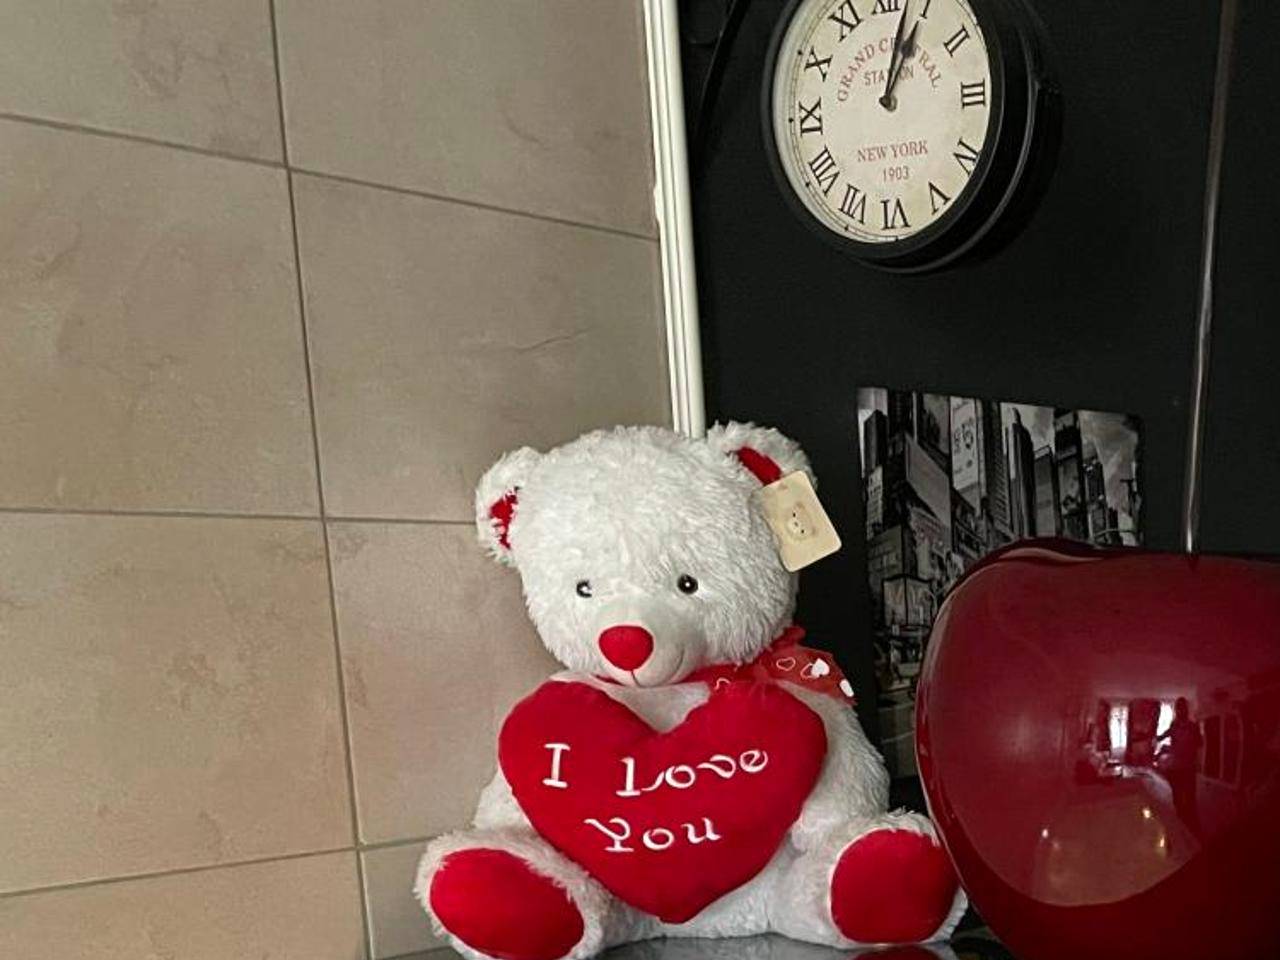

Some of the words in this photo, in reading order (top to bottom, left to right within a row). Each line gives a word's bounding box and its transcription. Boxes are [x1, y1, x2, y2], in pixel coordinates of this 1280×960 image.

[837, 44, 875, 102] GRAND
[865, 65, 915, 87] STAON
[857, 146, 887, 162] NEW
[890, 140, 928, 158] YORK
[883, 165, 909, 182] 1903
[542, 743, 570, 788] I
[615, 748, 768, 796] Love
[584, 816, 720, 852] You
